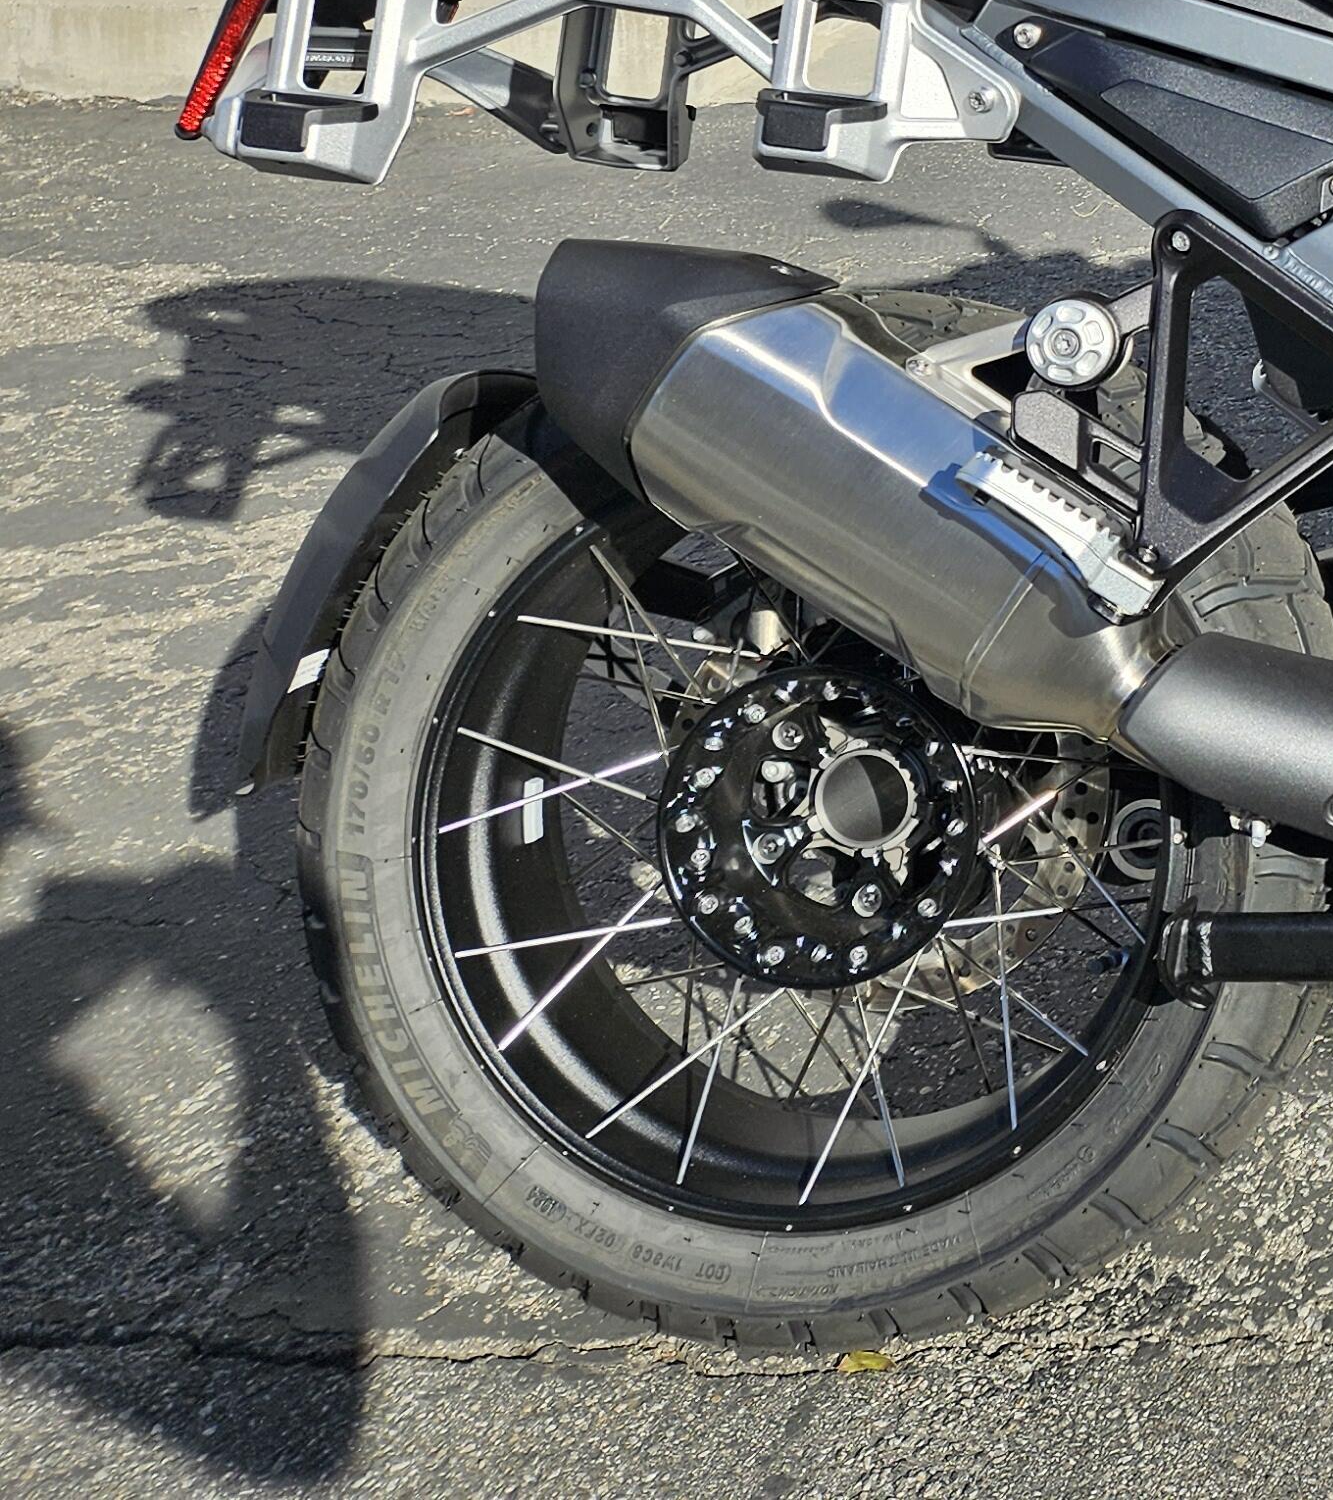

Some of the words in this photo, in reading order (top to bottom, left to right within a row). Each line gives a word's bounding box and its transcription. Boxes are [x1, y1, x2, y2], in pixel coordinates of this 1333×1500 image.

[347, 724, 381, 835] 170/60
[370, 693, 389, 718] R
[380, 650, 407, 687] 17
[336, 870, 447, 1119] MICHELIN
[693, 1260, 726, 1283] DOT
